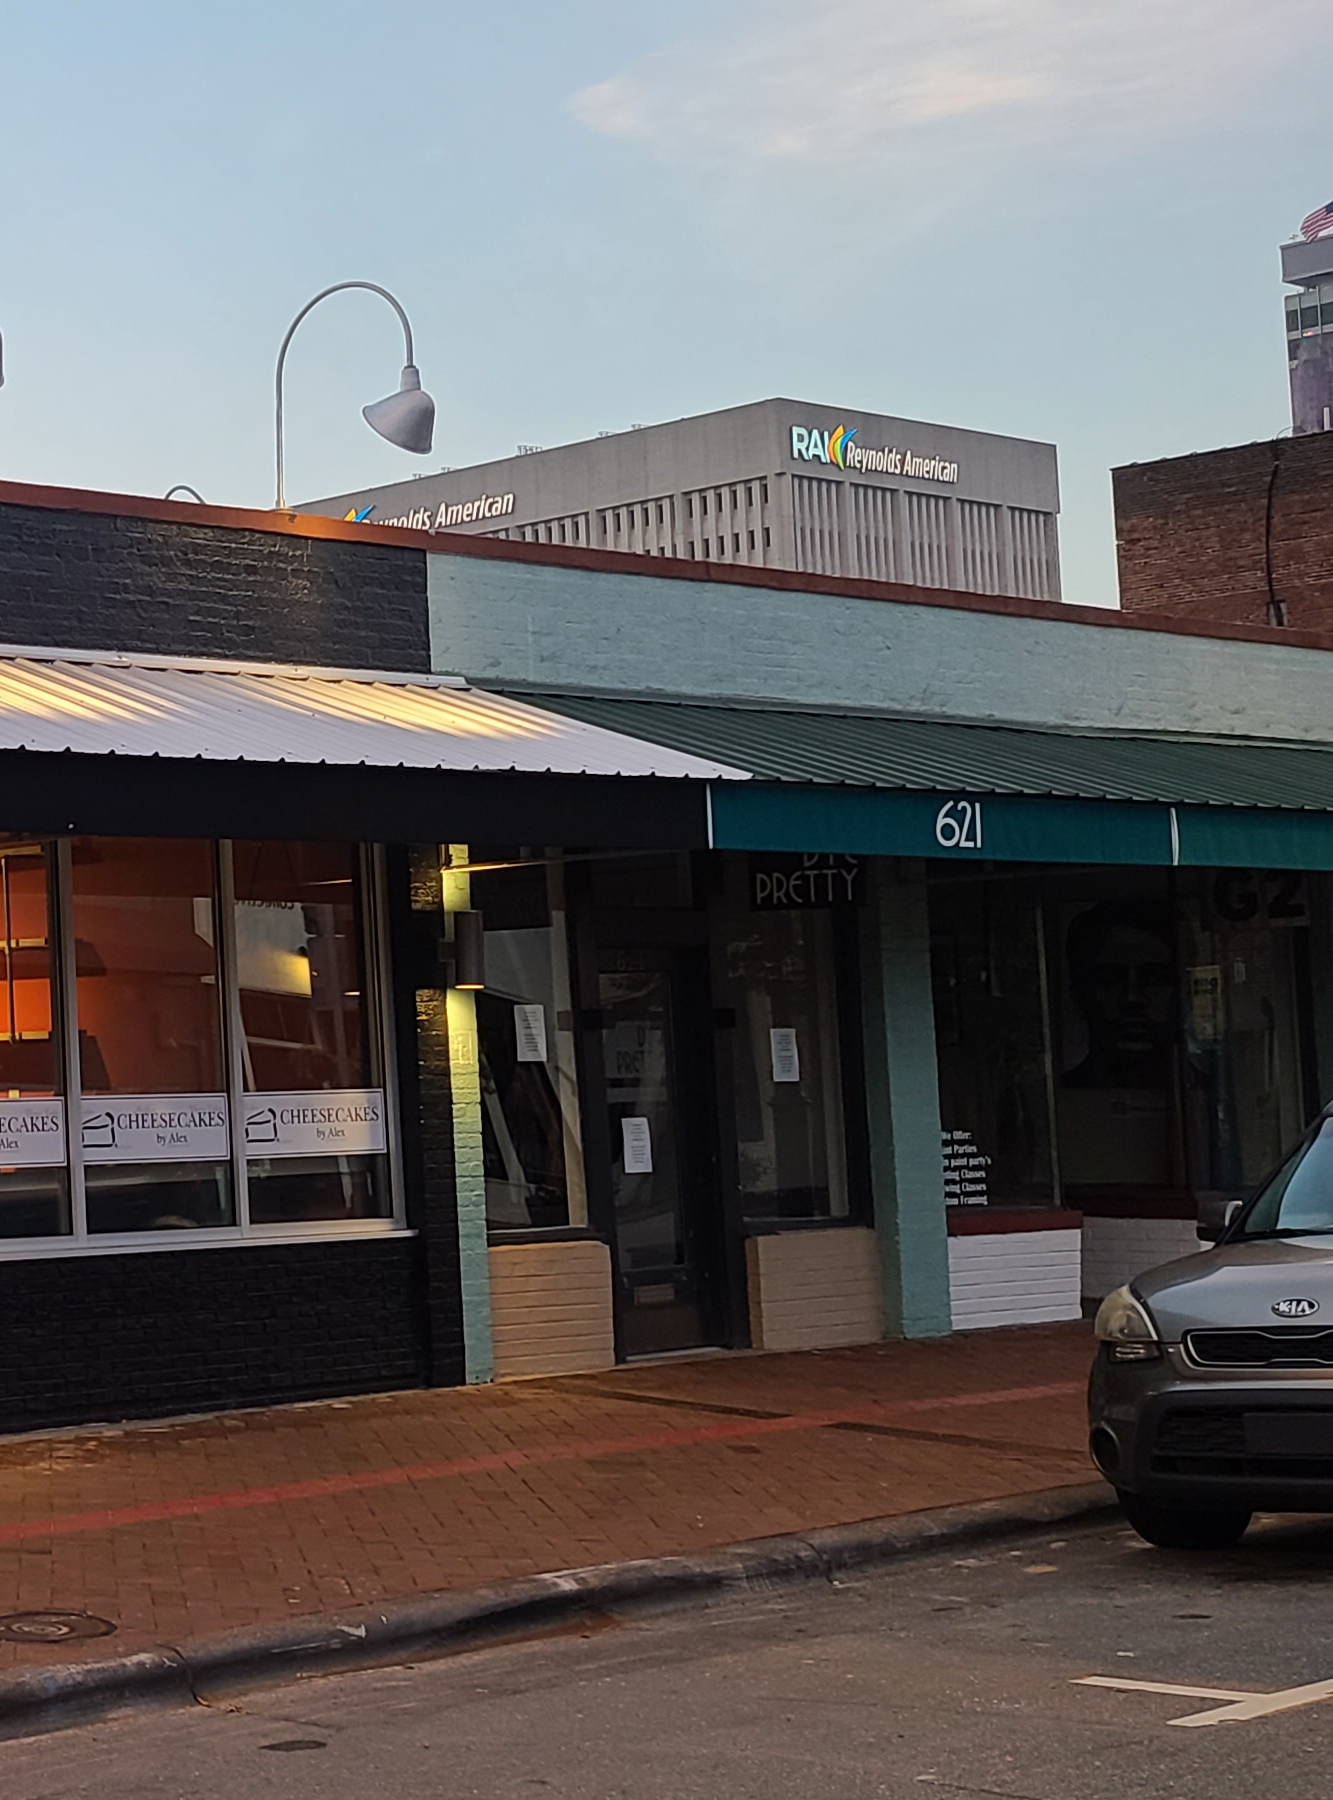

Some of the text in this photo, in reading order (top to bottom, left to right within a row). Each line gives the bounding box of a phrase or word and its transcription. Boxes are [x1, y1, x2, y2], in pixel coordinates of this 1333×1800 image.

[791, 425, 960, 484] RAI Reynolds American
[434, 492, 516, 530] American
[935, 801, 983, 849] 621
[755, 867, 859, 905] PRETTY
[117, 1111, 225, 1130] CHEESECAKES
[280, 1106, 380, 1125] CHEESECAKES
[156, 1132, 188, 1147] by Alex
[316, 1126, 346, 1141] by Alex
[954, 1144, 978, 1154] Parties
[961, 1169, 987, 1179] Classes
[962, 1182, 987, 1192] Classes
[960, 1194, 989, 1206] Framing
[1279, 1300, 1312, 1314] KIA
